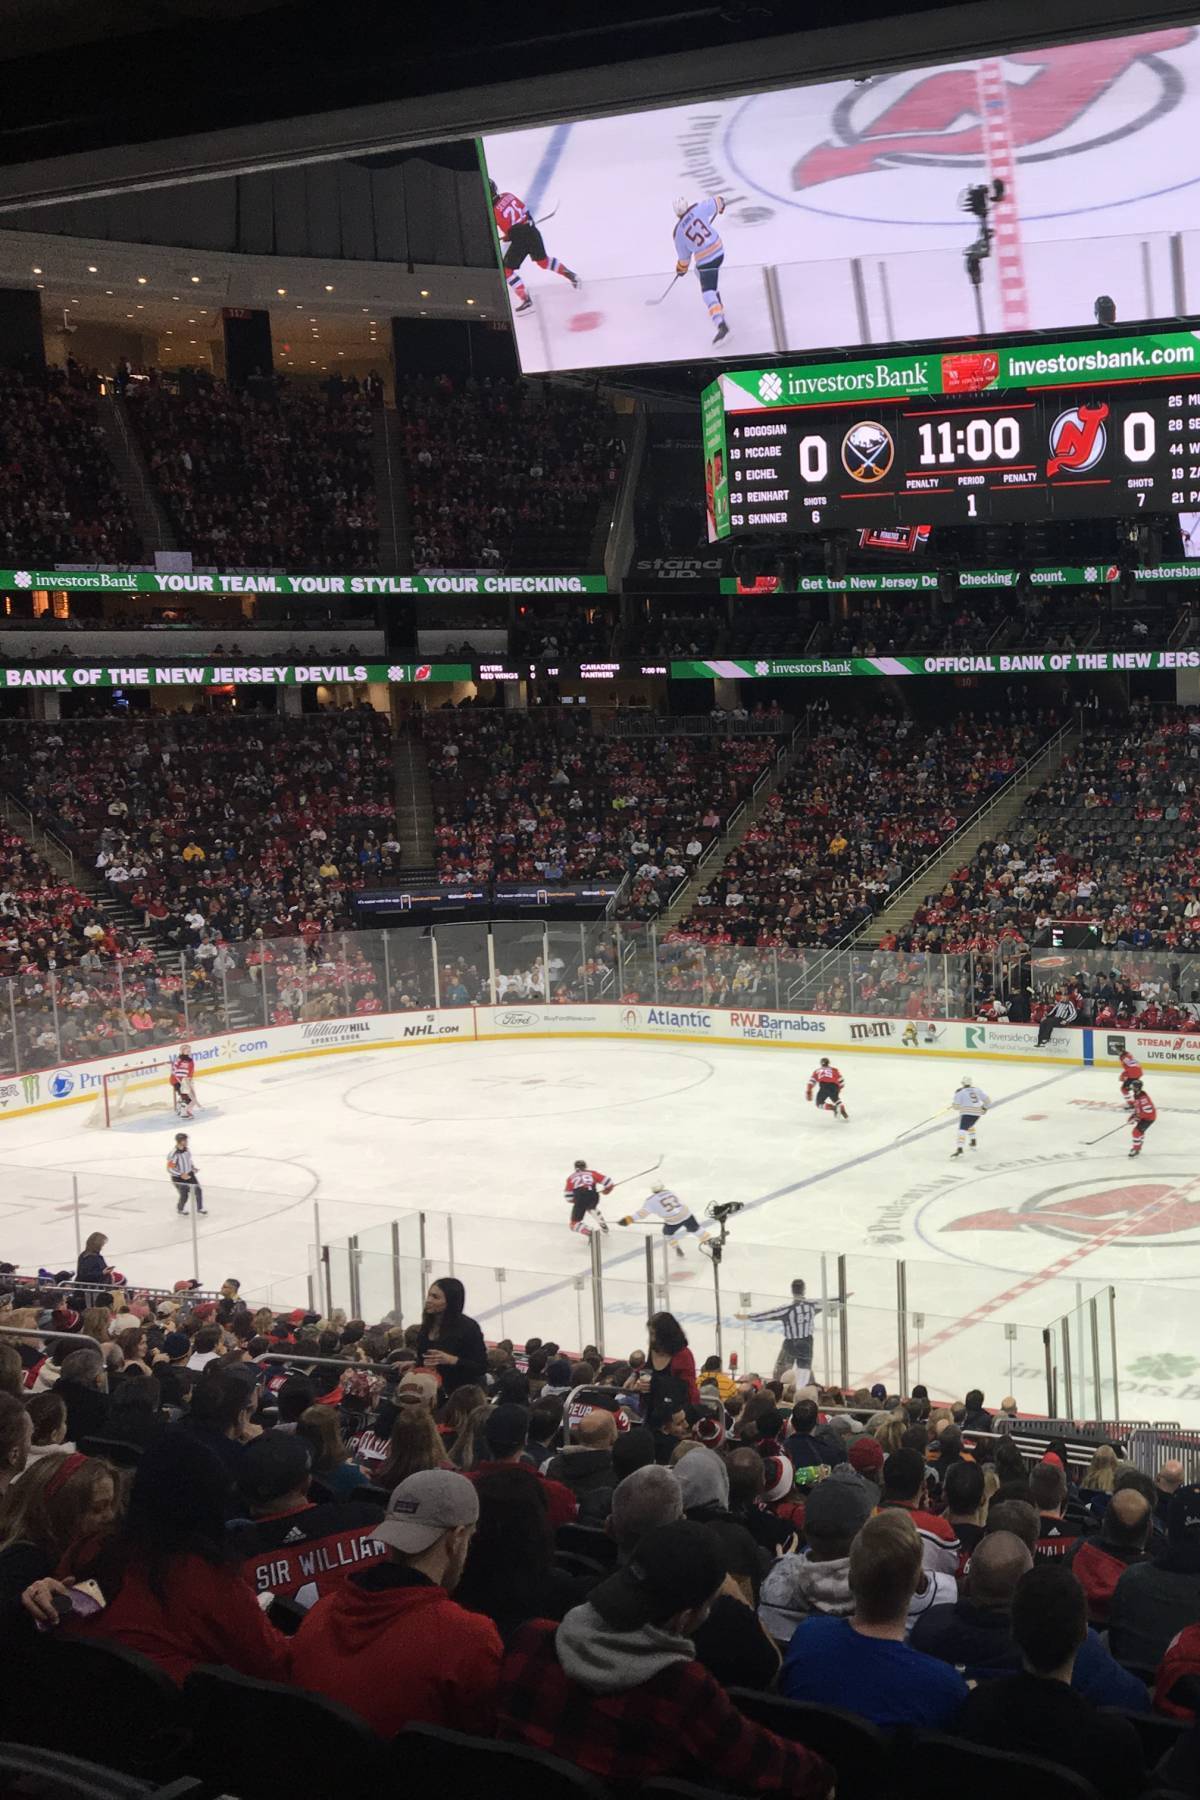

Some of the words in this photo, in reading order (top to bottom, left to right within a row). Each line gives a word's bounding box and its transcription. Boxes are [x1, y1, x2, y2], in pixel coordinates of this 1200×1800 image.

[685, 218, 711, 247] 53
[1008, 345, 1195, 378] investorsbank.com
[1168, 395, 1183, 408] 25
[732, 427, 740, 439] 4
[744, 423, 788, 438] BOGOSIAN
[1168, 418, 1183, 432] 28
[918, 417, 1020, 465] 11:00
[1123, 411, 1156, 463] 0
[730, 448, 741, 460] 19
[745, 445, 782, 459] MCCABE
[1169, 442, 1184, 456] 44
[799, 434, 829, 483] 0
[734, 470, 743, 482] 9
[746, 468, 778, 481] EICHEL
[957, 474, 985, 487] PERIOD
[1003, 471, 1038, 484] PENALTY
[1171, 466, 1184, 480] 19
[906, 478, 939, 490] PENALTY
[1127, 477, 1154, 489] SHOTS
[730, 491, 743, 504] 23
[747, 489, 789, 503] REINHART
[803, 496, 828, 507] SHOTS
[1136, 493, 1146, 508] 7
[1171, 491, 1186, 504] 21
[966, 494, 977, 518] 1
[731, 513, 744, 526] 53
[747, 511, 788, 526] SKINNER
[811, 510, 820, 524] 6
[154, 575, 214, 592] YOUR
[219, 575, 282, 593] TEAM.
[288, 576, 345, 592] YOUR
[350, 577, 418, 593] STYLE.
[424, 577, 479, 592] YOUR
[484, 577, 587, 593] CHECKING.
[801, 577, 824, 590] Get
[850, 575, 877, 590] New
[880, 574, 919, 592] Jersey
[959, 571, 1012, 587] Checking
[924, 656, 996, 673] OFFICIAL
[999, 654, 1046, 671] BANK
[1049, 654, 1072, 670] OF
[1076, 653, 1108, 669] THE
[1112, 652, 1153, 669] NEW
[6, 668, 67, 686] BANK
[72, 668, 103, 685] OF
[108, 667, 149, 685] THE
[155, 667, 205, 684] NEW
[211, 666, 294, 683] JERSEY
[295, 665, 367, 682] DEVILS
[647, 1008, 711, 1029] Atlantic
[403, 1024, 460, 1038] NHL.COM
[743, 1027, 783, 1040] HEALTH
[989, 1031, 1021, 1044] Riverside
[1137, 1037, 1170, 1049] STREAM
[1147, 1051, 1165, 1061] LIVE
[1166, 1052, 1177, 1061] ON
[1178, 1053, 1195, 1062] MSG
[256, 1559, 291, 1590] SIR
